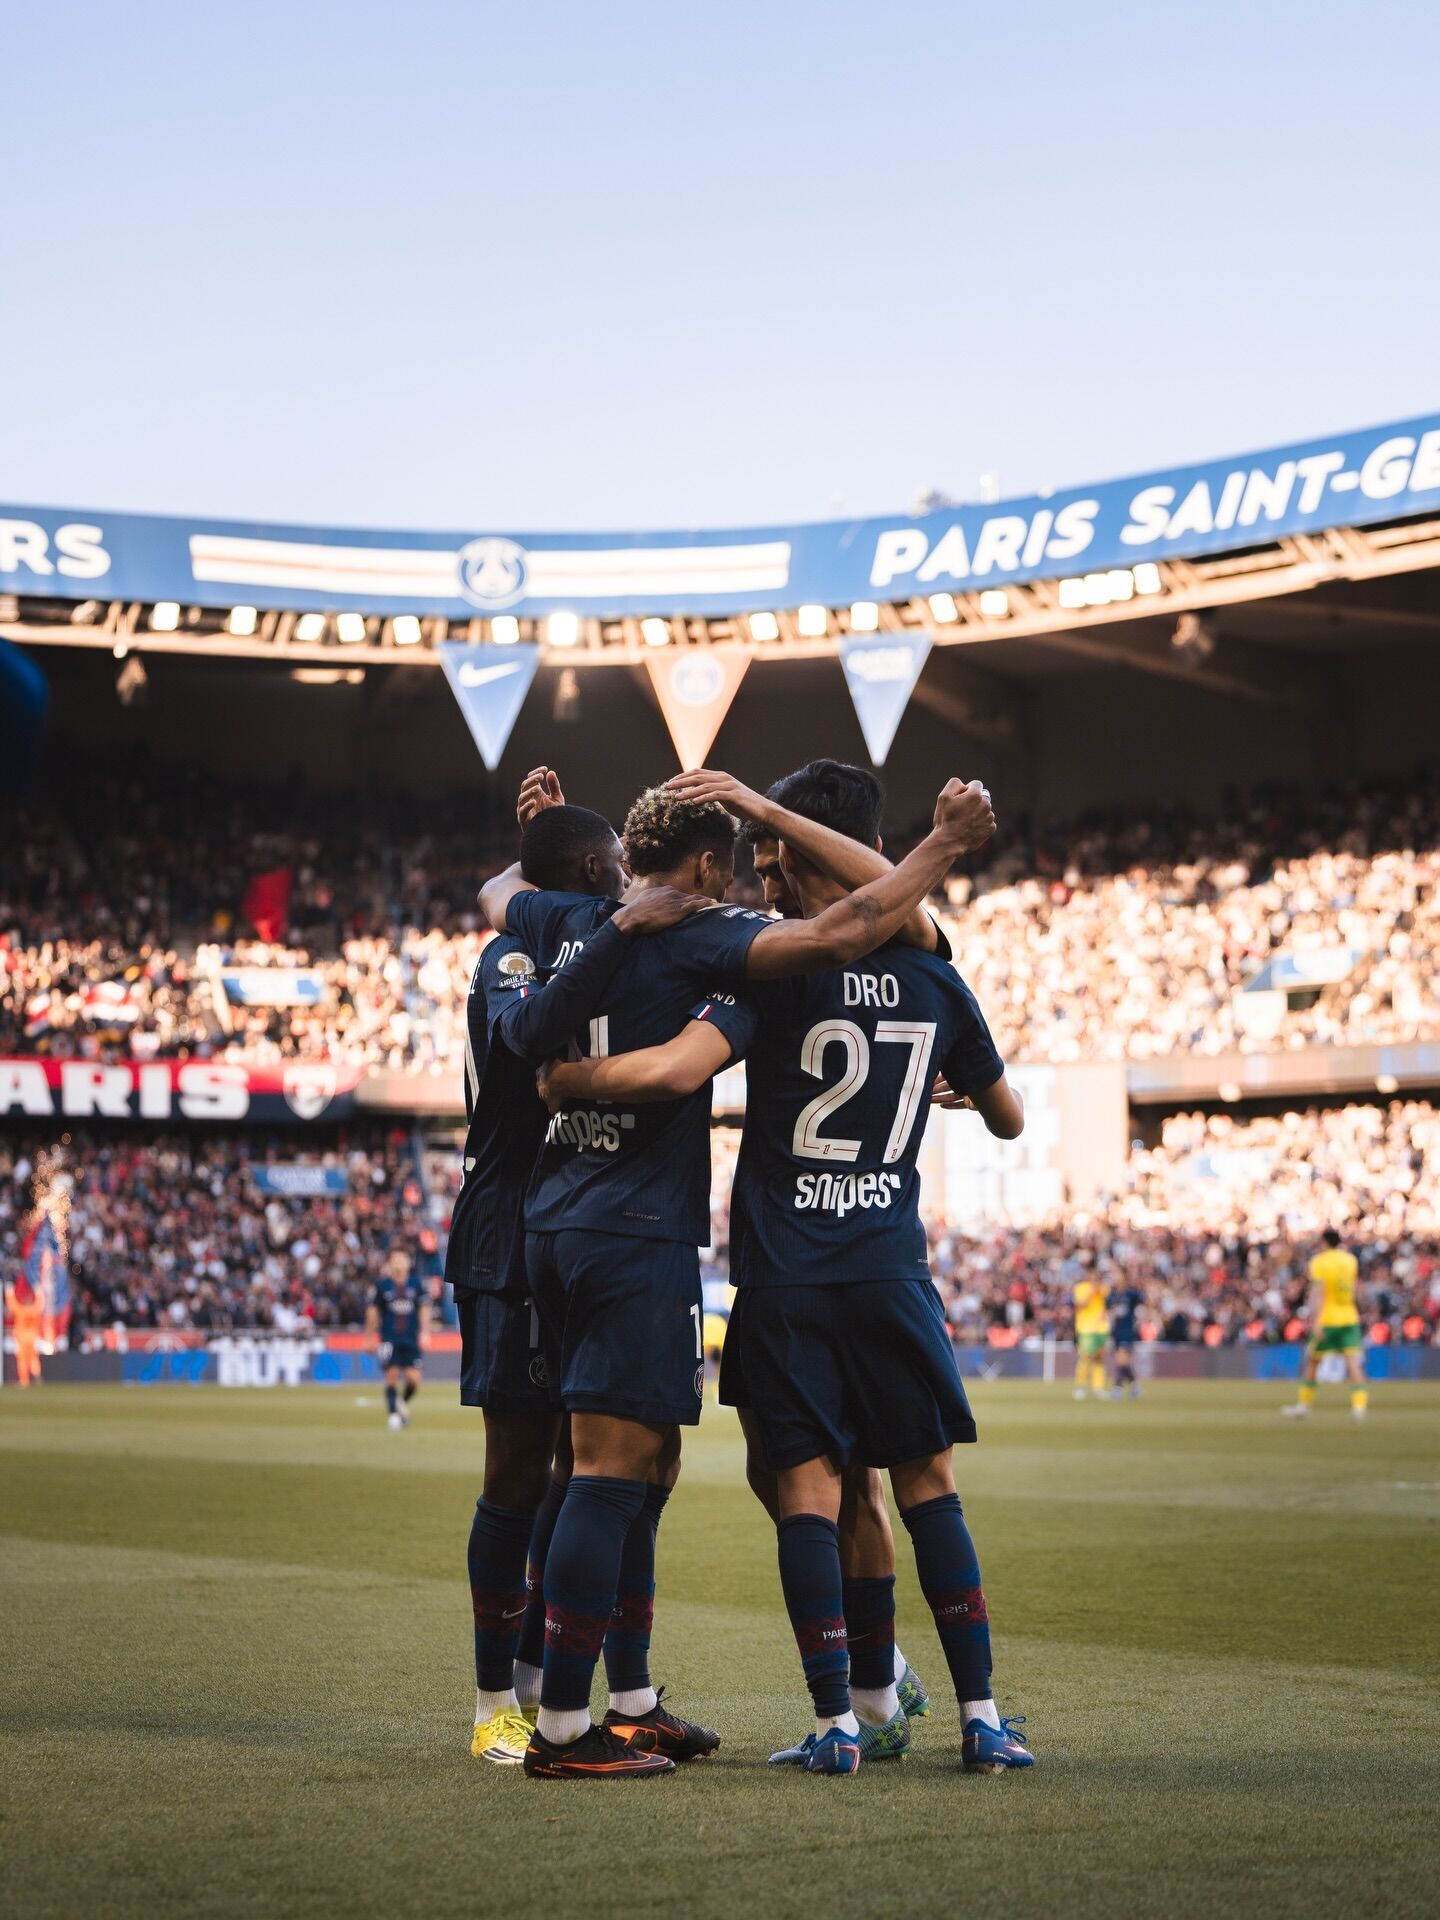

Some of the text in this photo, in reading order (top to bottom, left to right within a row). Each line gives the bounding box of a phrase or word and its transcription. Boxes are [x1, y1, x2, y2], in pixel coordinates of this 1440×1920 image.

[0, 518, 111, 579] RS
[869, 499, 1100, 587] PARIS
[843, 971, 899, 1008] DRO
[792, 1018, 937, 1164] 27
[794, 1171, 892, 1218] snipes
